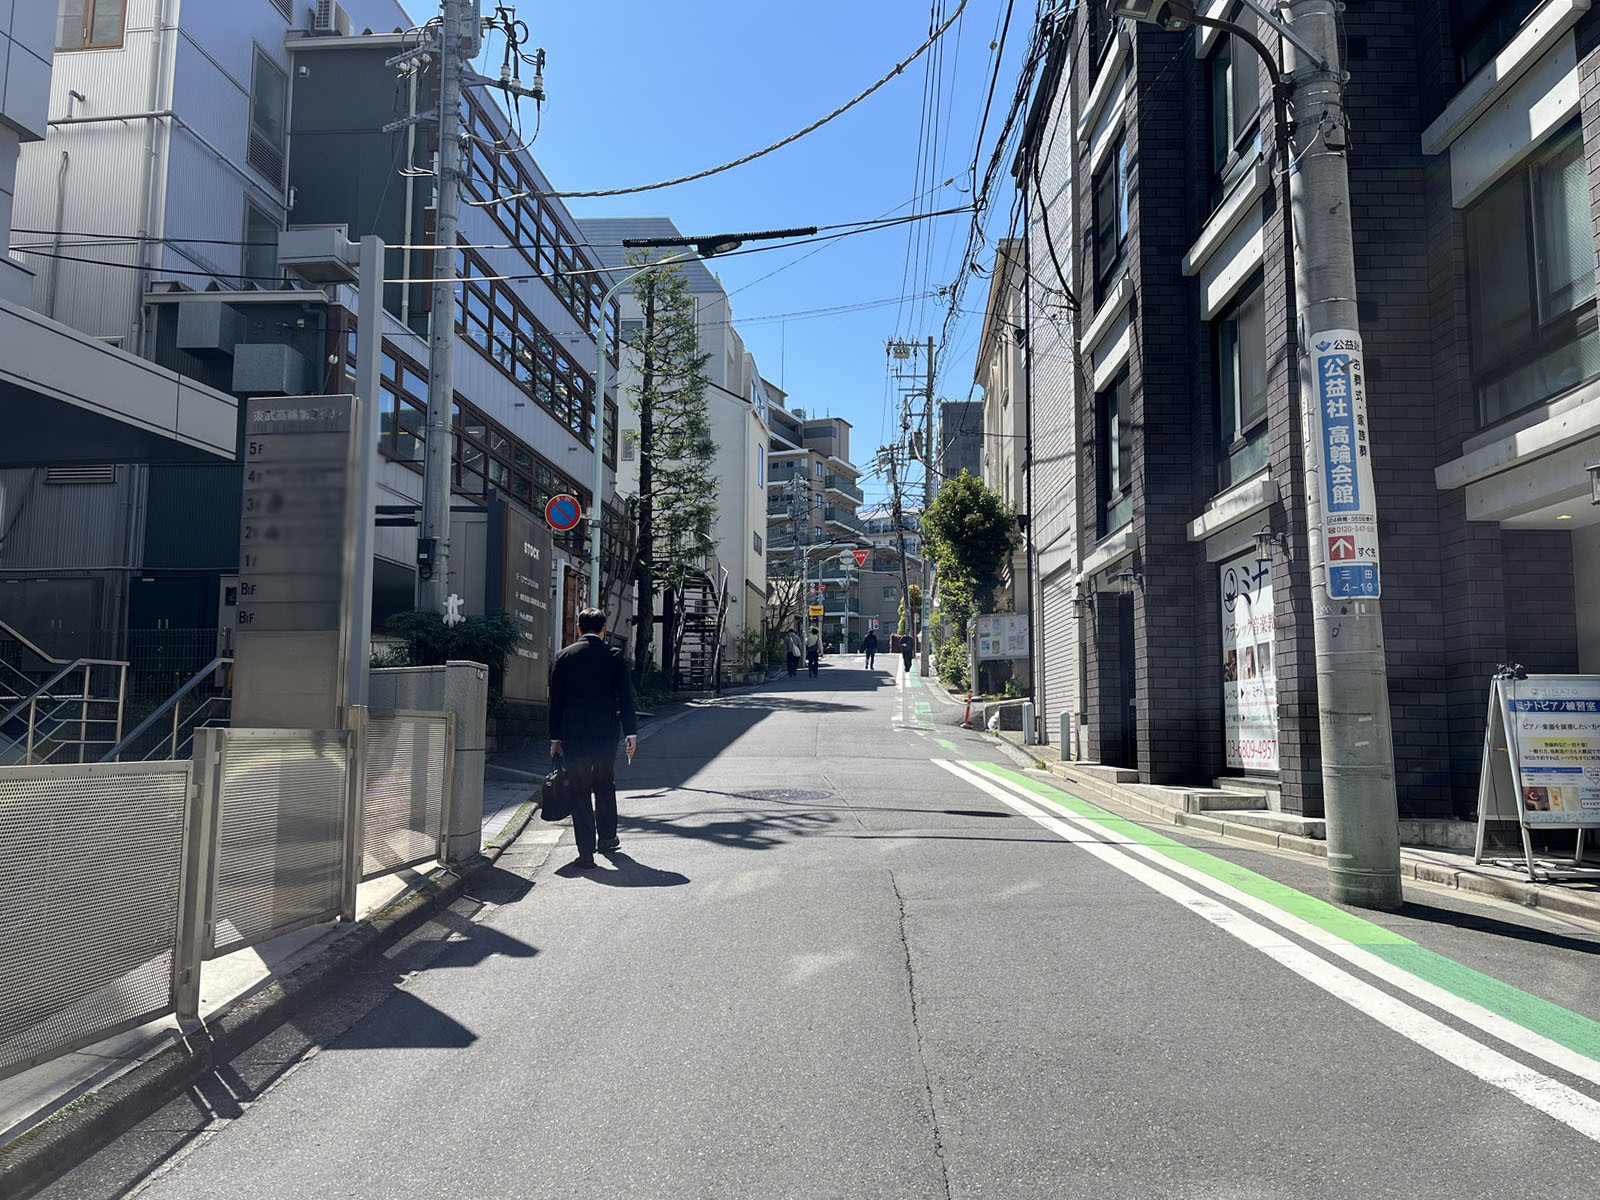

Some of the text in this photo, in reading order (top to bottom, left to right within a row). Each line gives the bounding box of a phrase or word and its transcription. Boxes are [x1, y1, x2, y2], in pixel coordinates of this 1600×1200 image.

[1324, 358, 1355, 505] 公益社 高輪会館
[249, 442, 264, 455] 5F
[524, 541, 540, 561] STOCK
[1340, 569, 1373, 580] 三田
[1342, 582, 1373, 593] 4-19
[1516, 700, 1597, 712] ミナトピアノ練習室
[1227, 739, 1276, 760] 03-6809-4957
